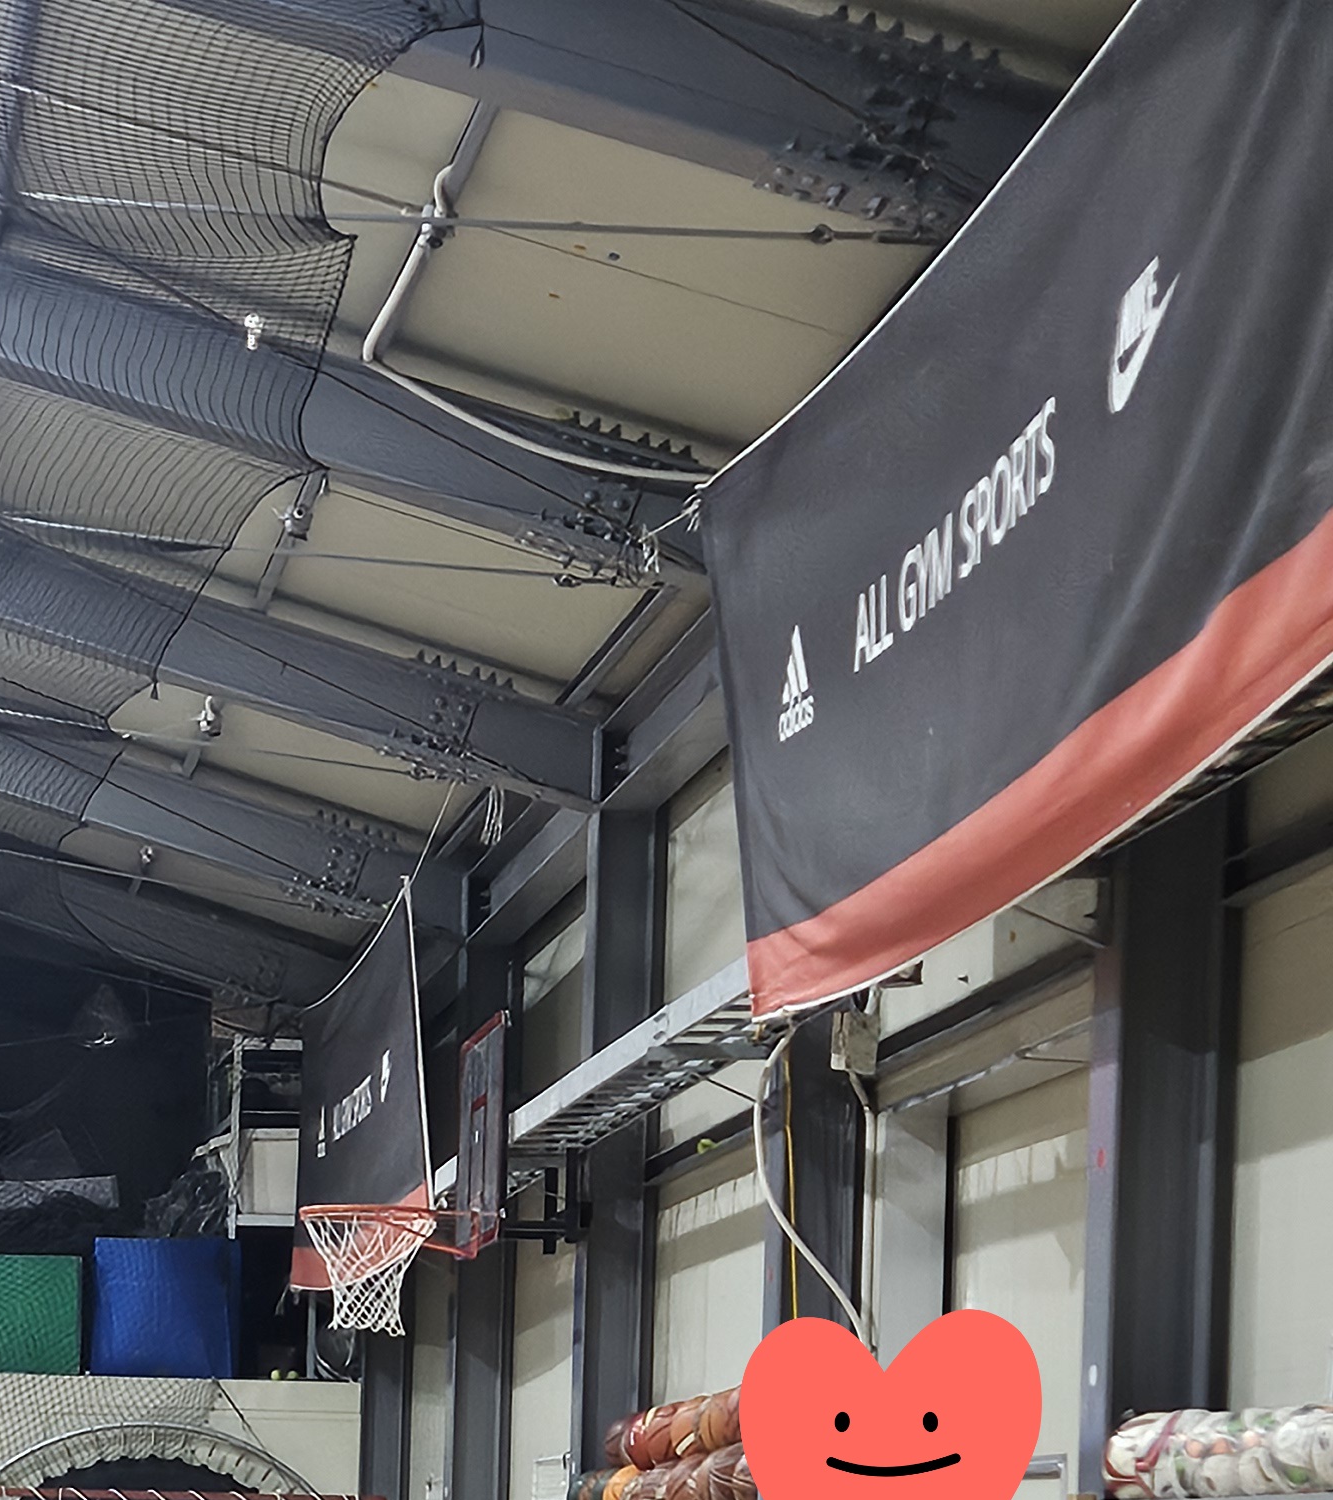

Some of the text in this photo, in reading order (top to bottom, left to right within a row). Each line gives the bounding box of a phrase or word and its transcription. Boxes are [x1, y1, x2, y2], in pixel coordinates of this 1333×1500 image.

[853, 396, 1056, 673] ALL GYM SPORTS
[779, 695, 814, 742] adidas
